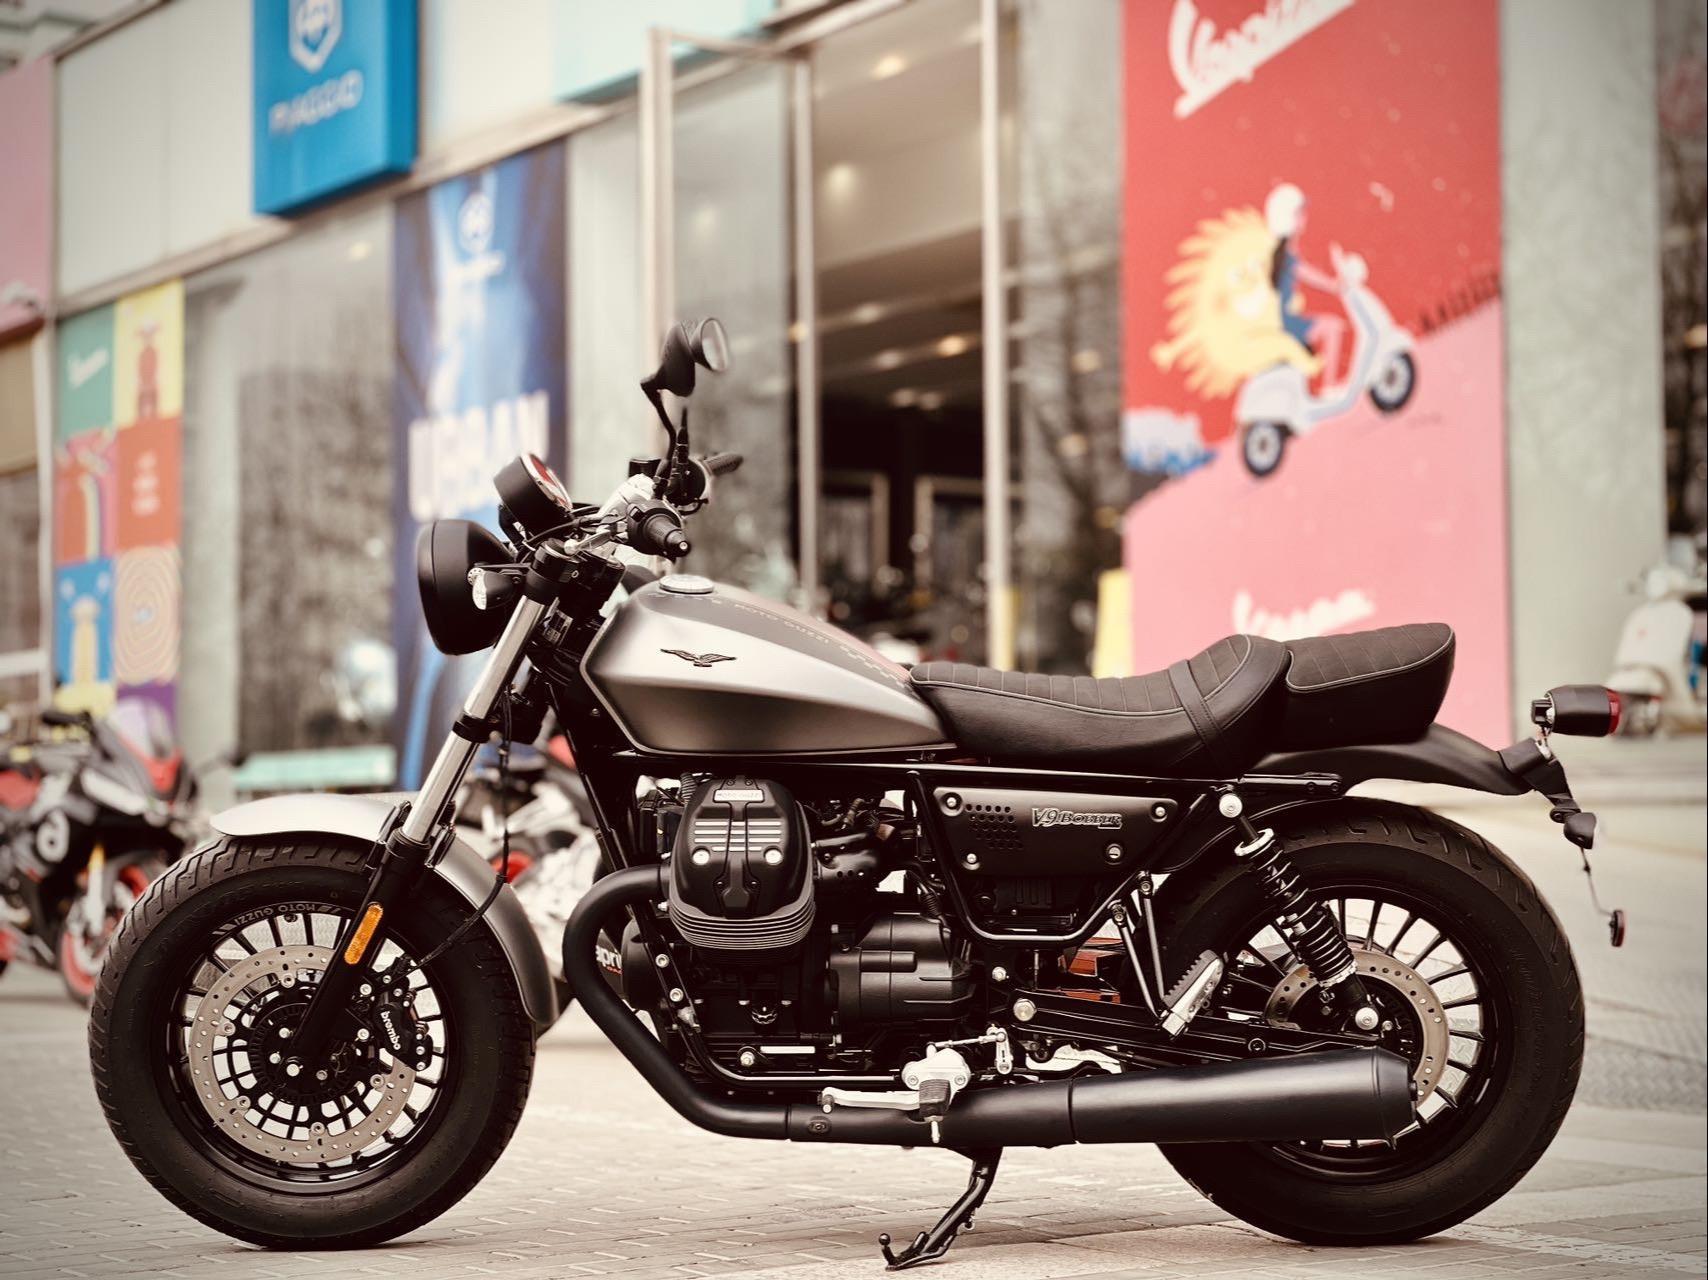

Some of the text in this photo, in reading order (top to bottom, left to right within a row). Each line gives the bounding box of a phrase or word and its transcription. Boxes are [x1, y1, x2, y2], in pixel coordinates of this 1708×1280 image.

[234, 903, 315, 926] MOTO GUZZI
[380, 1010, 401, 1050] brembo
